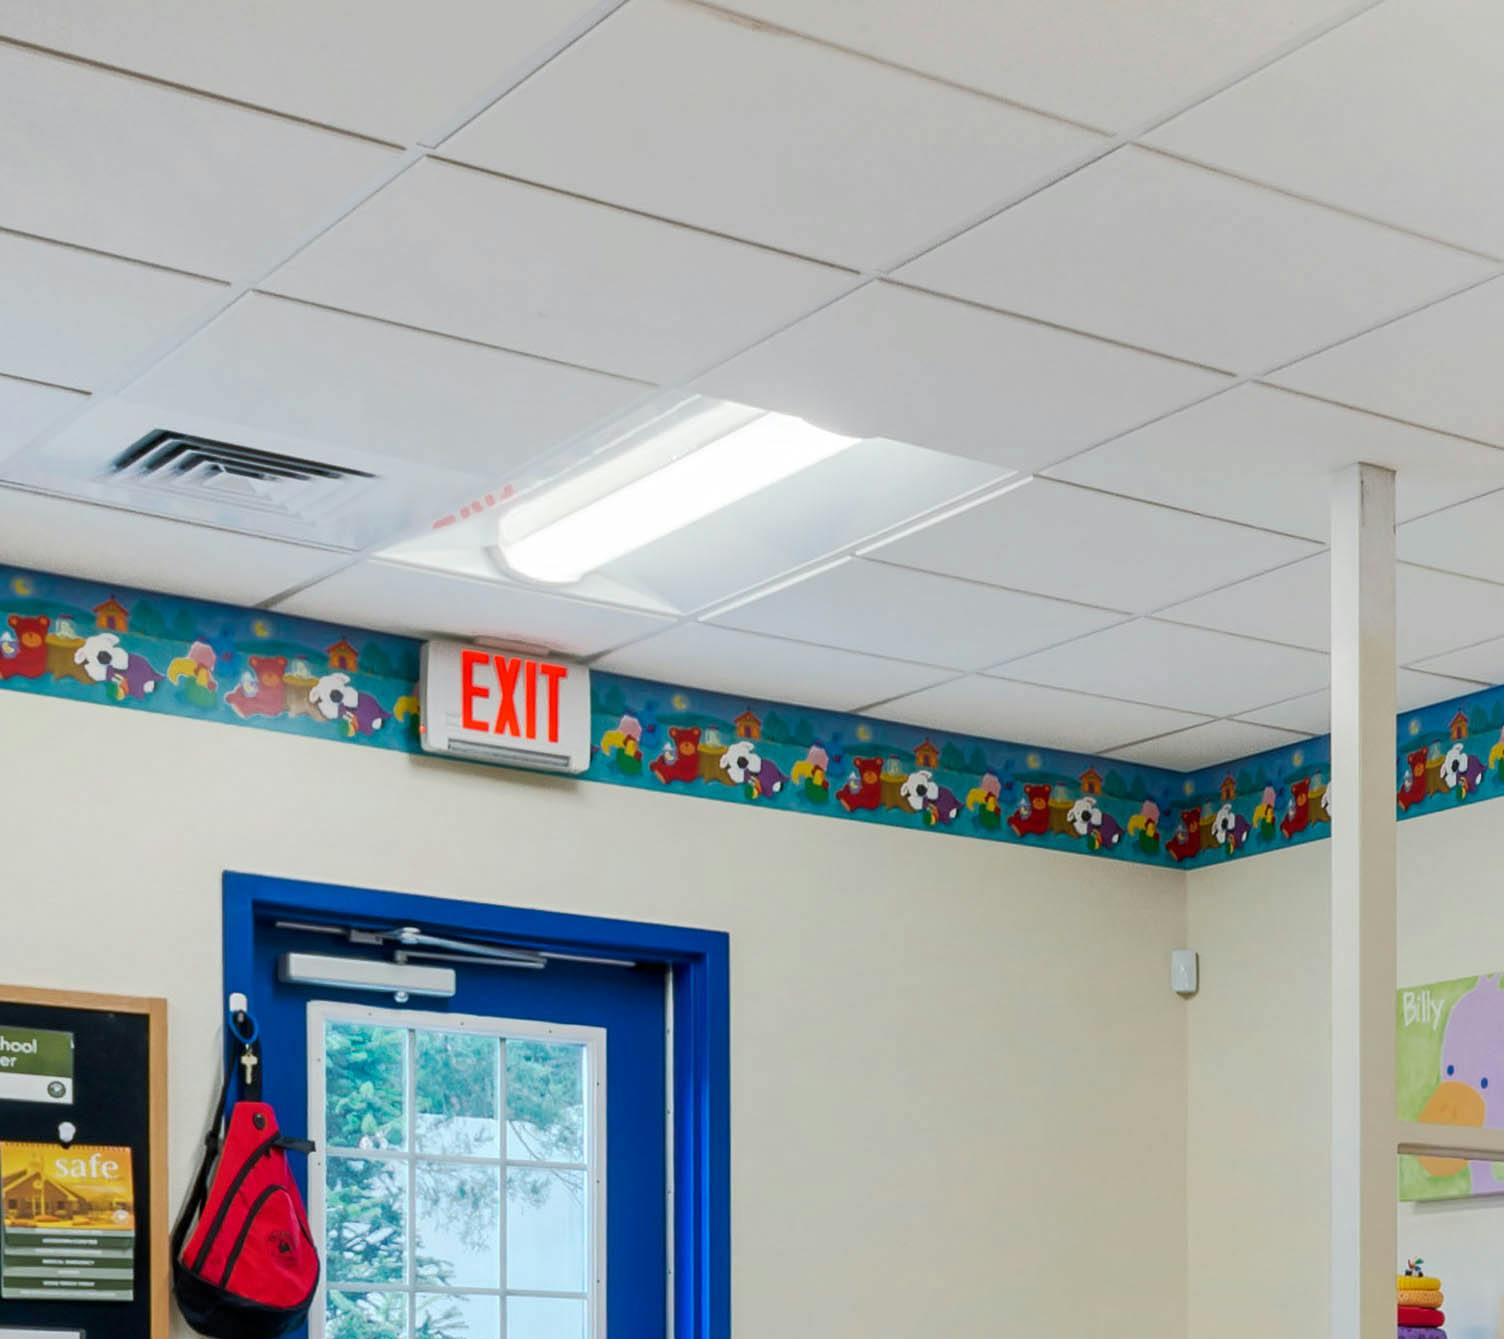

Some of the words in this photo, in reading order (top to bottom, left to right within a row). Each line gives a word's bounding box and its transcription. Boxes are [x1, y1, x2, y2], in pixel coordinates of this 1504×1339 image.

[461, 648, 568, 743] EXIT
[1402, 991, 1445, 1031] Billy
[54, 1152, 120, 1180] safe
